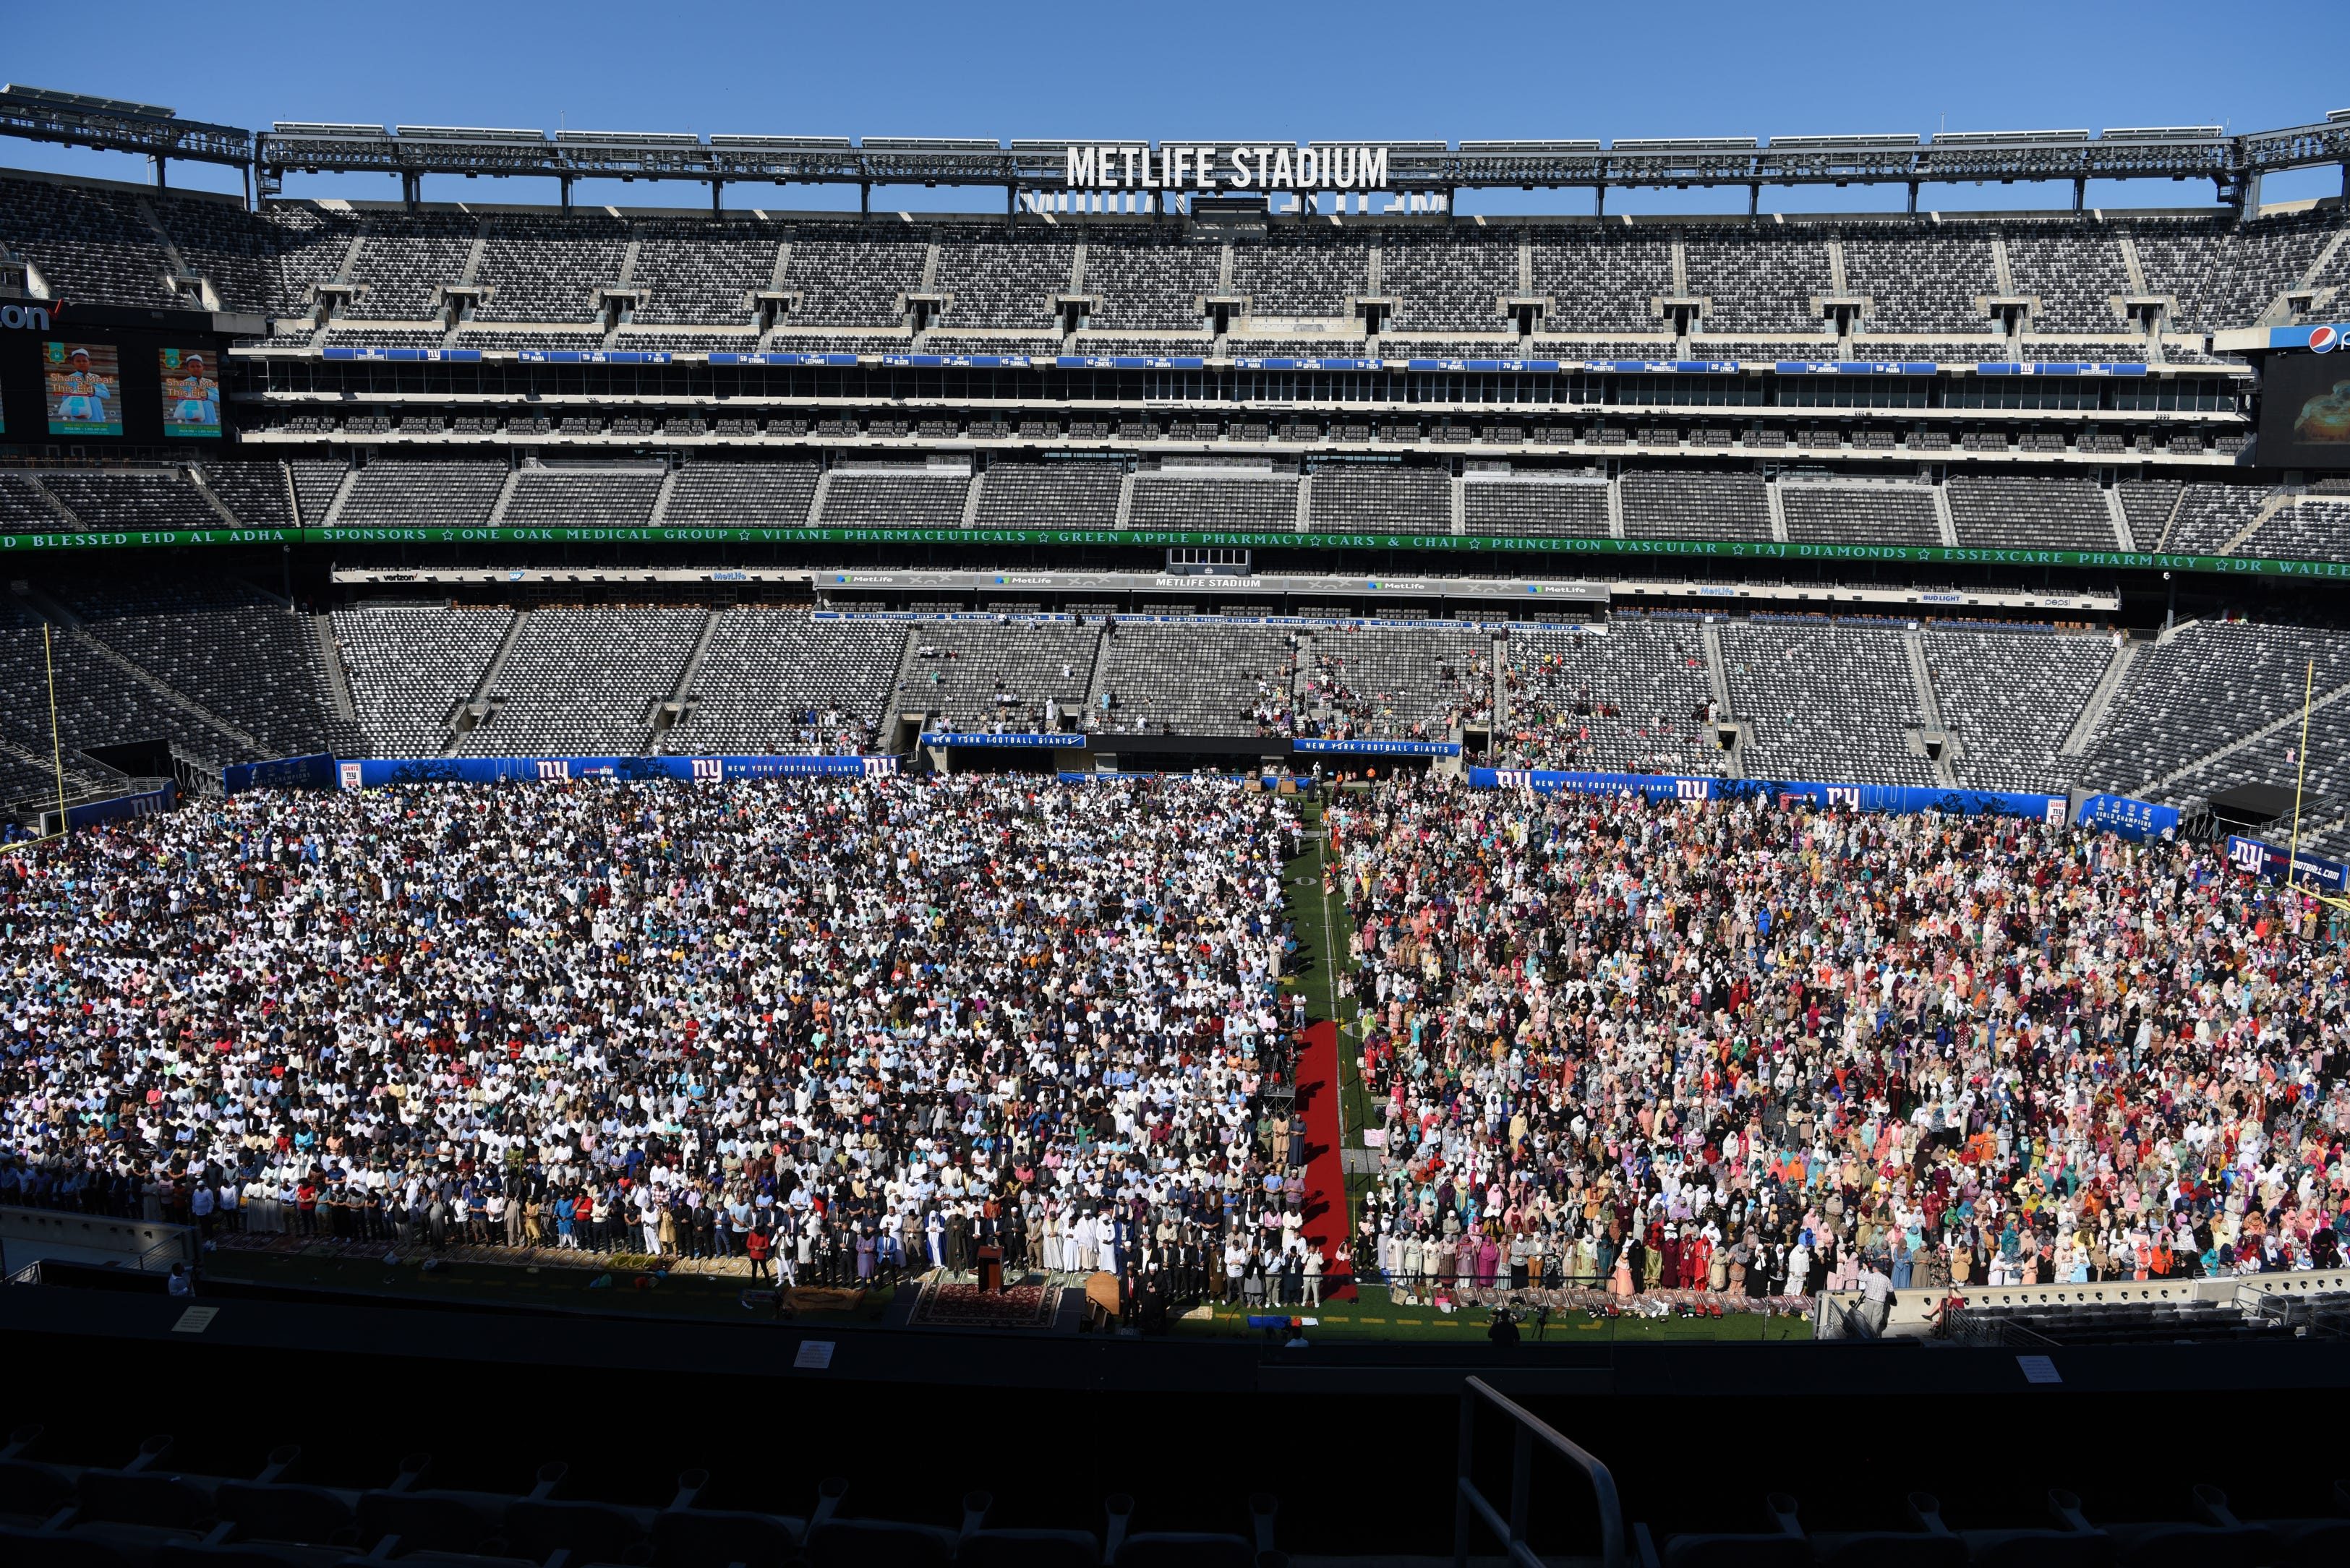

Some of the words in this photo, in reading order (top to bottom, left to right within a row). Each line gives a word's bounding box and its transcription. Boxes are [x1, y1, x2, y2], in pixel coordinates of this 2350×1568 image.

[1067, 147, 1216, 187] METLIFE
[1231, 147, 1388, 188] STADIUM
[0, 305, 50, 330] on
[51, 373, 82, 382] Share
[86, 375, 114, 384] Meat
[167, 377, 197, 387] Share
[51, 384, 74, 393] This
[168, 388, 188, 397] This
[191, 388, 207, 397] Eid
[33, 534, 127, 547] BLESSED
[141, 533, 176, 544] EID
[190, 531, 215, 542] AL
[229, 531, 284, 541] ADHA
[323, 529, 427, 539] SPONSORS
[462, 530, 500, 539] ONE
[513, 530, 553, 539] OAK
[566, 530, 651, 539] MEDICAL
[665, 530, 728, 539] GROUP
[763, 530, 832, 540] VITANE
[845, 530, 1026, 541] PHARMACEUTICALS
[1059, 532, 1119, 542] GREEN
[1132, 533, 1189, 543] APPLE
[1202, 534, 1302, 545] PHARMACY
[1328, 536, 1375, 546] CARS
[1388, 536, 1400, 547] &
[1414, 536, 1458, 547] CHAI
[1492, 539, 1601, 550] PRINCETON
[1616, 541, 1717, 553] VASCULAR
[1753, 544, 1785, 557] TAJ
[1800, 546, 1907, 558] DIAMONDS
[1944, 549, 2064, 564] ESSEXCARE
[2079, 554, 2199, 567] PHARMACY
[2234, 560, 2263, 571] DR
[714, 572, 746, 580] MetLife
[1701, 586, 1735, 595] MetLife
[275, 771, 311, 783] CHAMPIONS
[346, 771, 356, 780] ny
[599, 766, 613, 775] WFAN
[692, 759, 722, 783] ny
[1676, 780, 1708, 804] ny
[2116, 814, 2152, 828] CHAMPIONS
[2235, 840, 2264, 874] ny
[2290, 860, 2340, 881] OOTBALL.COM
